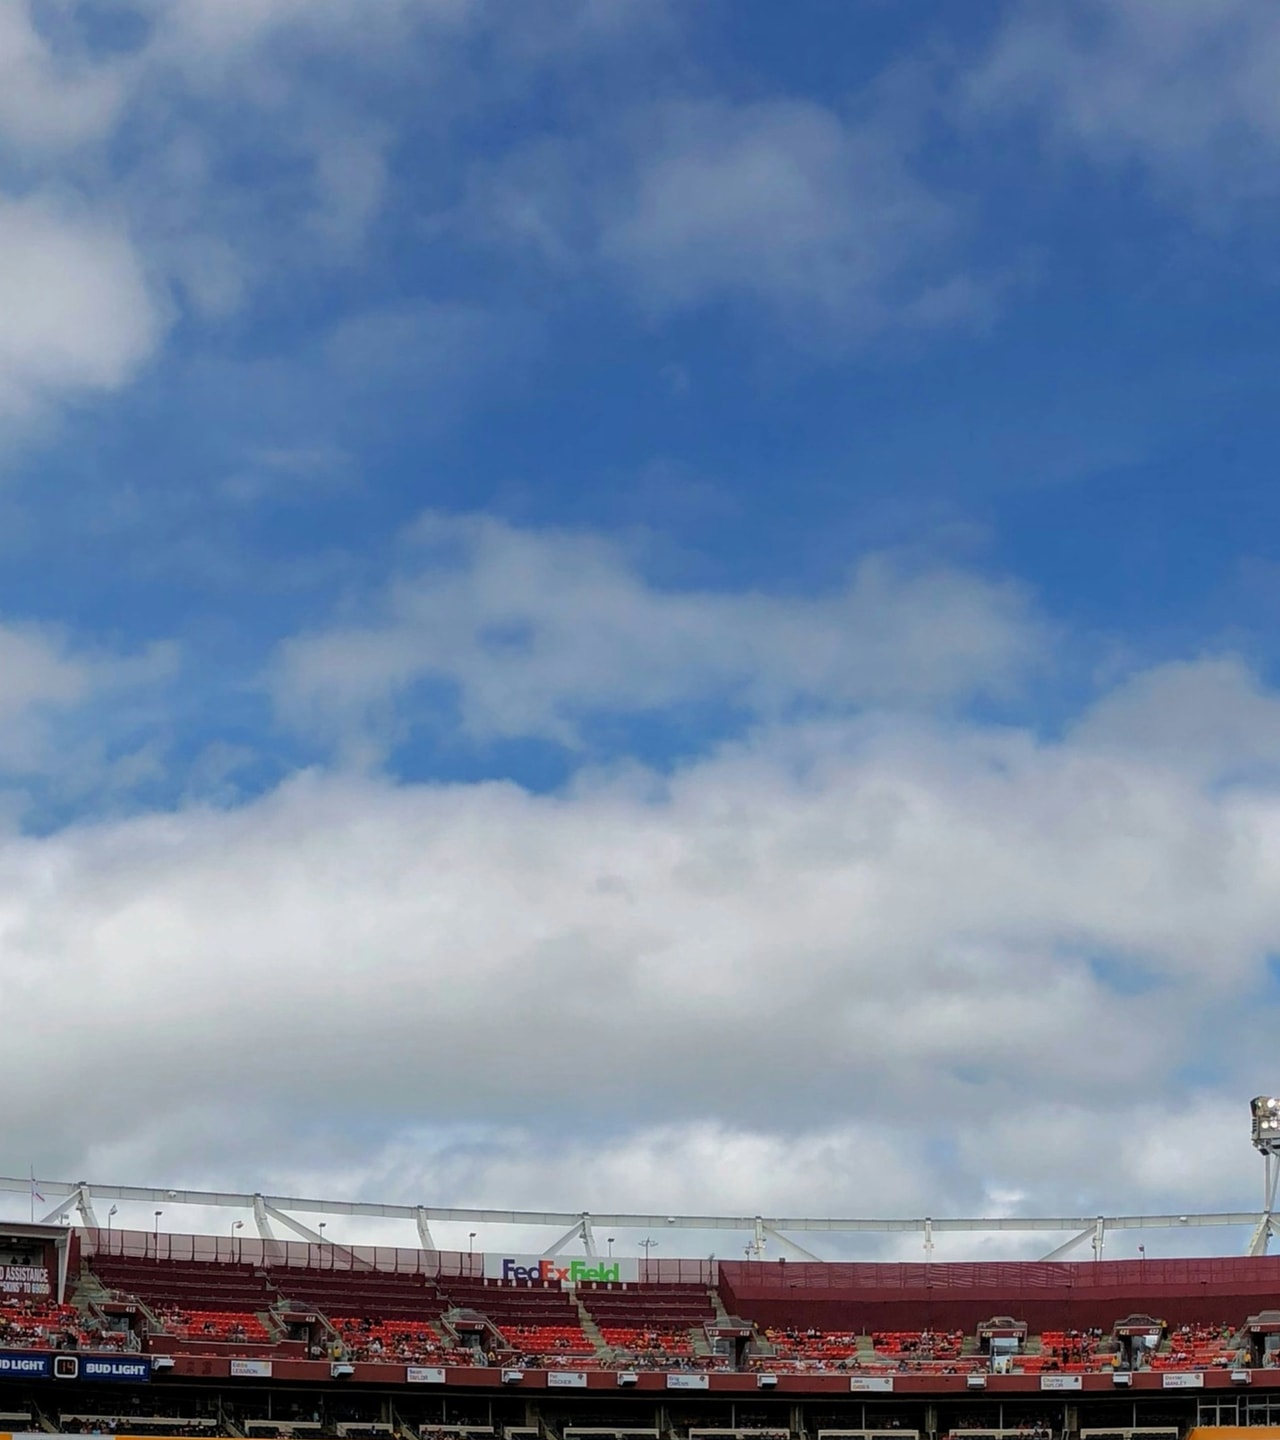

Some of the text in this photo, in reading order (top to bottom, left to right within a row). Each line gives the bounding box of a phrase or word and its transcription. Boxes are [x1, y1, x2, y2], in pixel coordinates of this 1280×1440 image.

[503, 1259, 619, 1282] FedExField
[11, 1360, 45, 1372] LIGHT
[86, 1364, 146, 1376] BUD LIGHT
